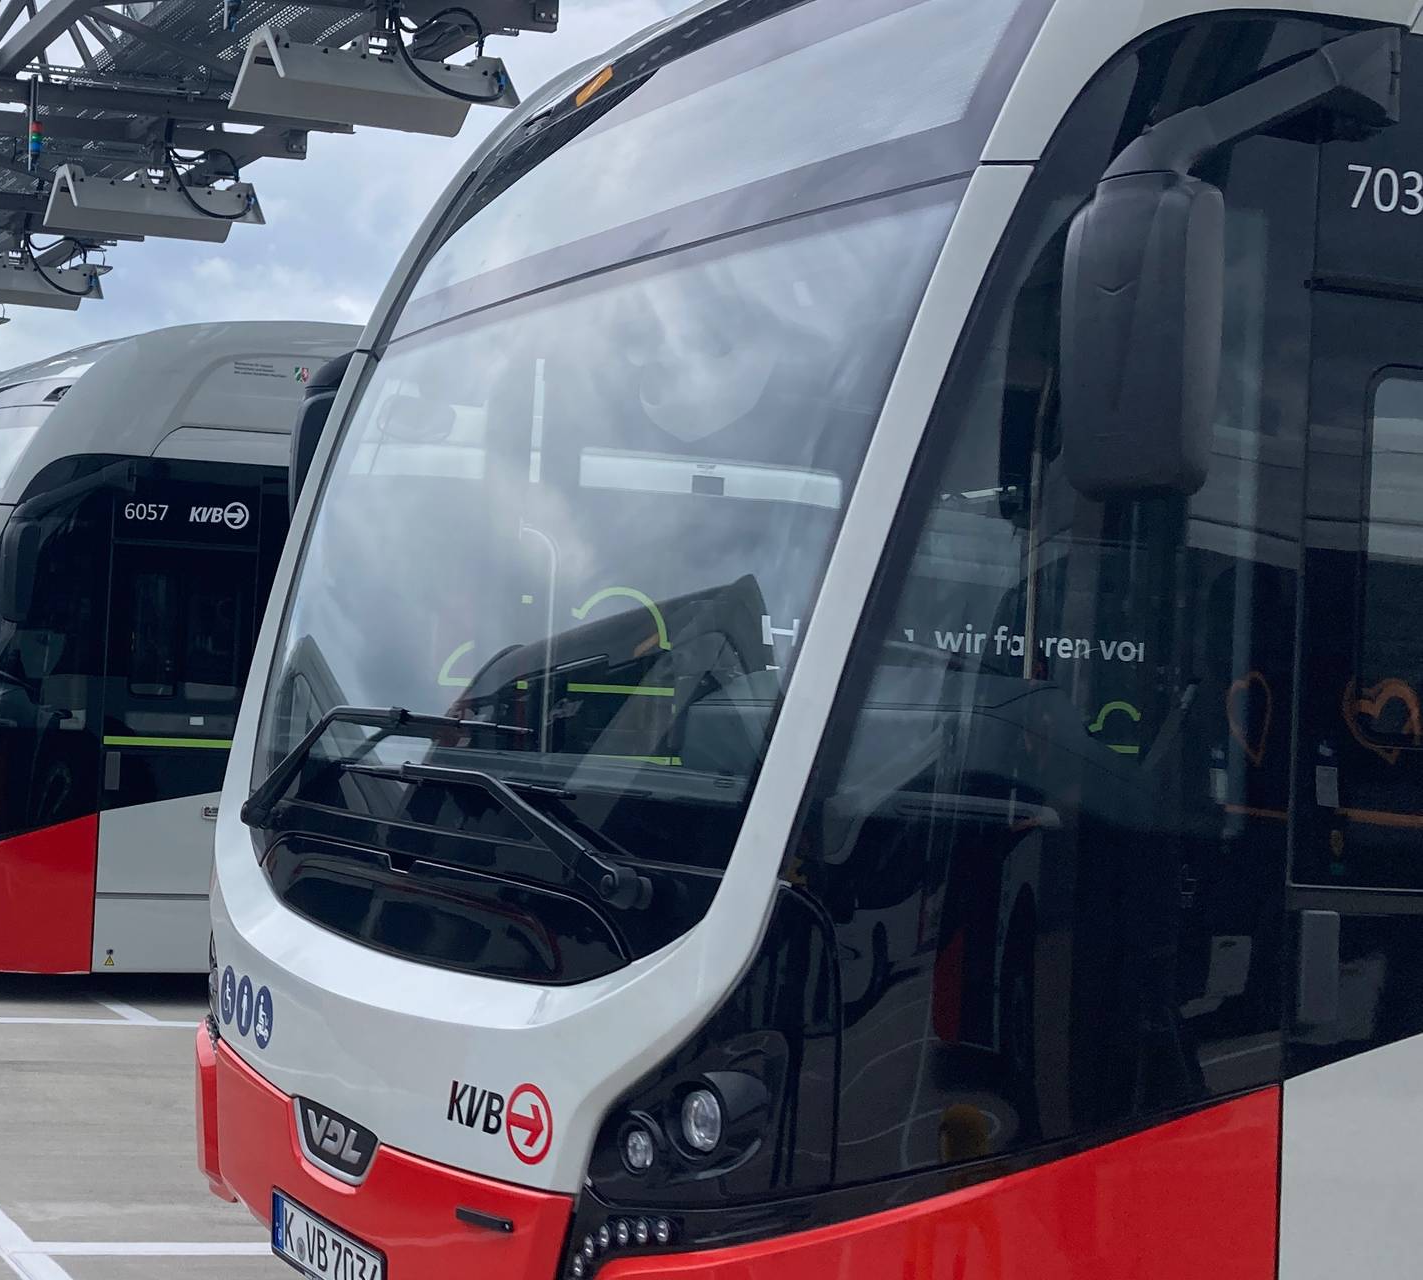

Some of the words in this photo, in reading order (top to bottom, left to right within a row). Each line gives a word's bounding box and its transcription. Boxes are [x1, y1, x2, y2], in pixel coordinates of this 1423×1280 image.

[1347, 164, 1423, 215] 703
[124, 503, 169, 520] 6057
[189, 506, 224, 523] KVB
[935, 623, 986, 654] wir
[994, 625, 1090, 660] faren
[447, 1080, 505, 1135] KVB
[307, 1108, 362, 1165] VDL
[284, 1207, 295, 1253] K
